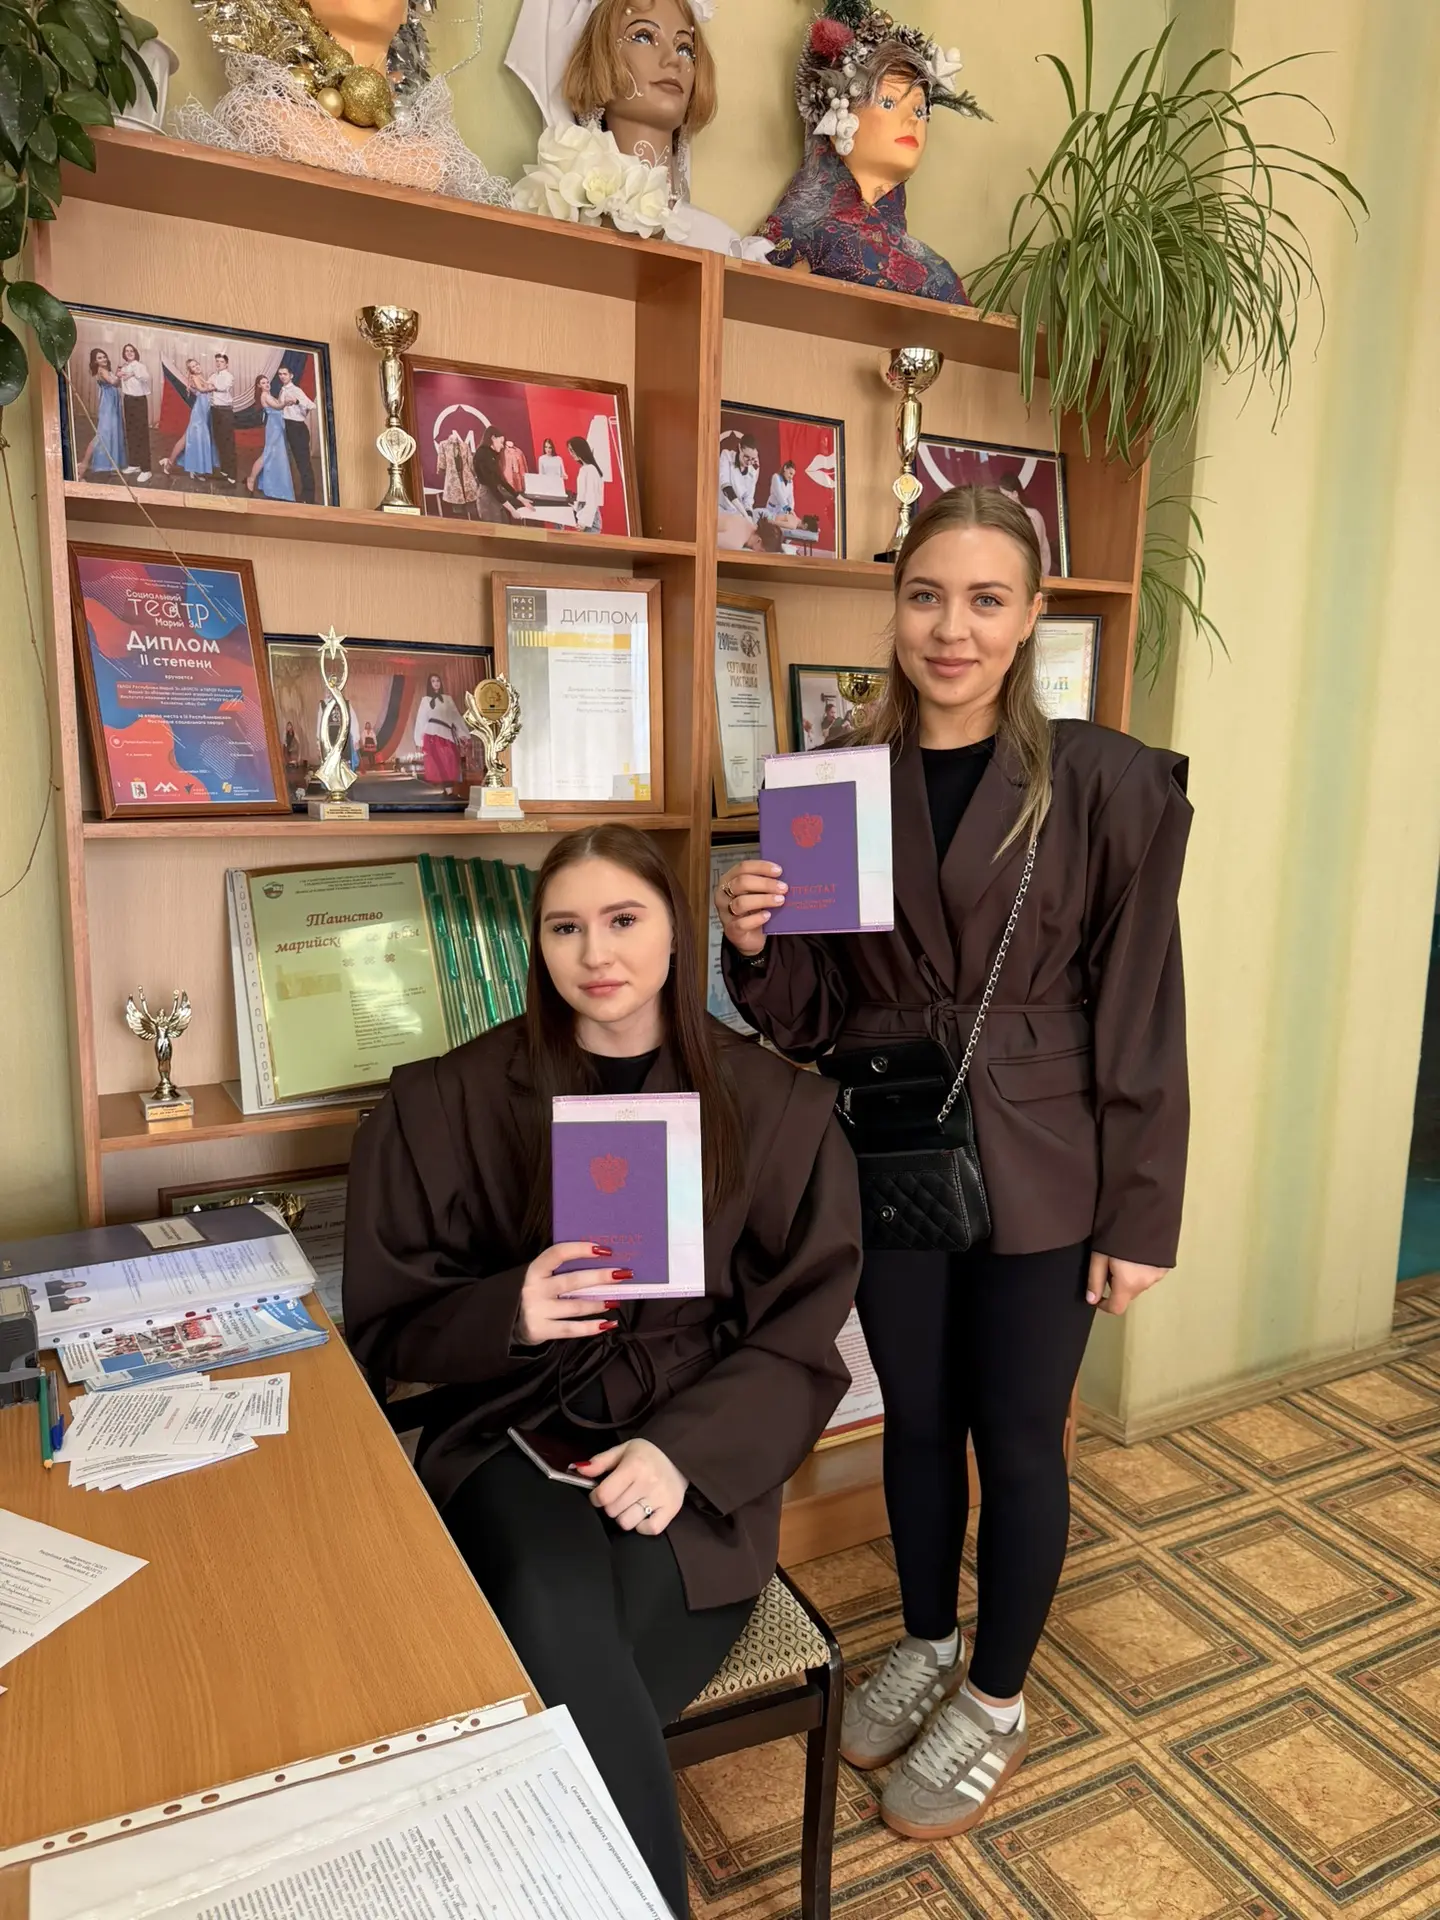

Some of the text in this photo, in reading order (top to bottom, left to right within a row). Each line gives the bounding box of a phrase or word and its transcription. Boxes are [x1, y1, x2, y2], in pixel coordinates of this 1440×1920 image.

[126, 588, 182, 602] Социальный
[155, 617, 185, 630] Марий
[560, 609, 638, 625] ДИПЛОМ
[153, 656, 212, 669] степени
[306, 911, 384, 928] Таинство
